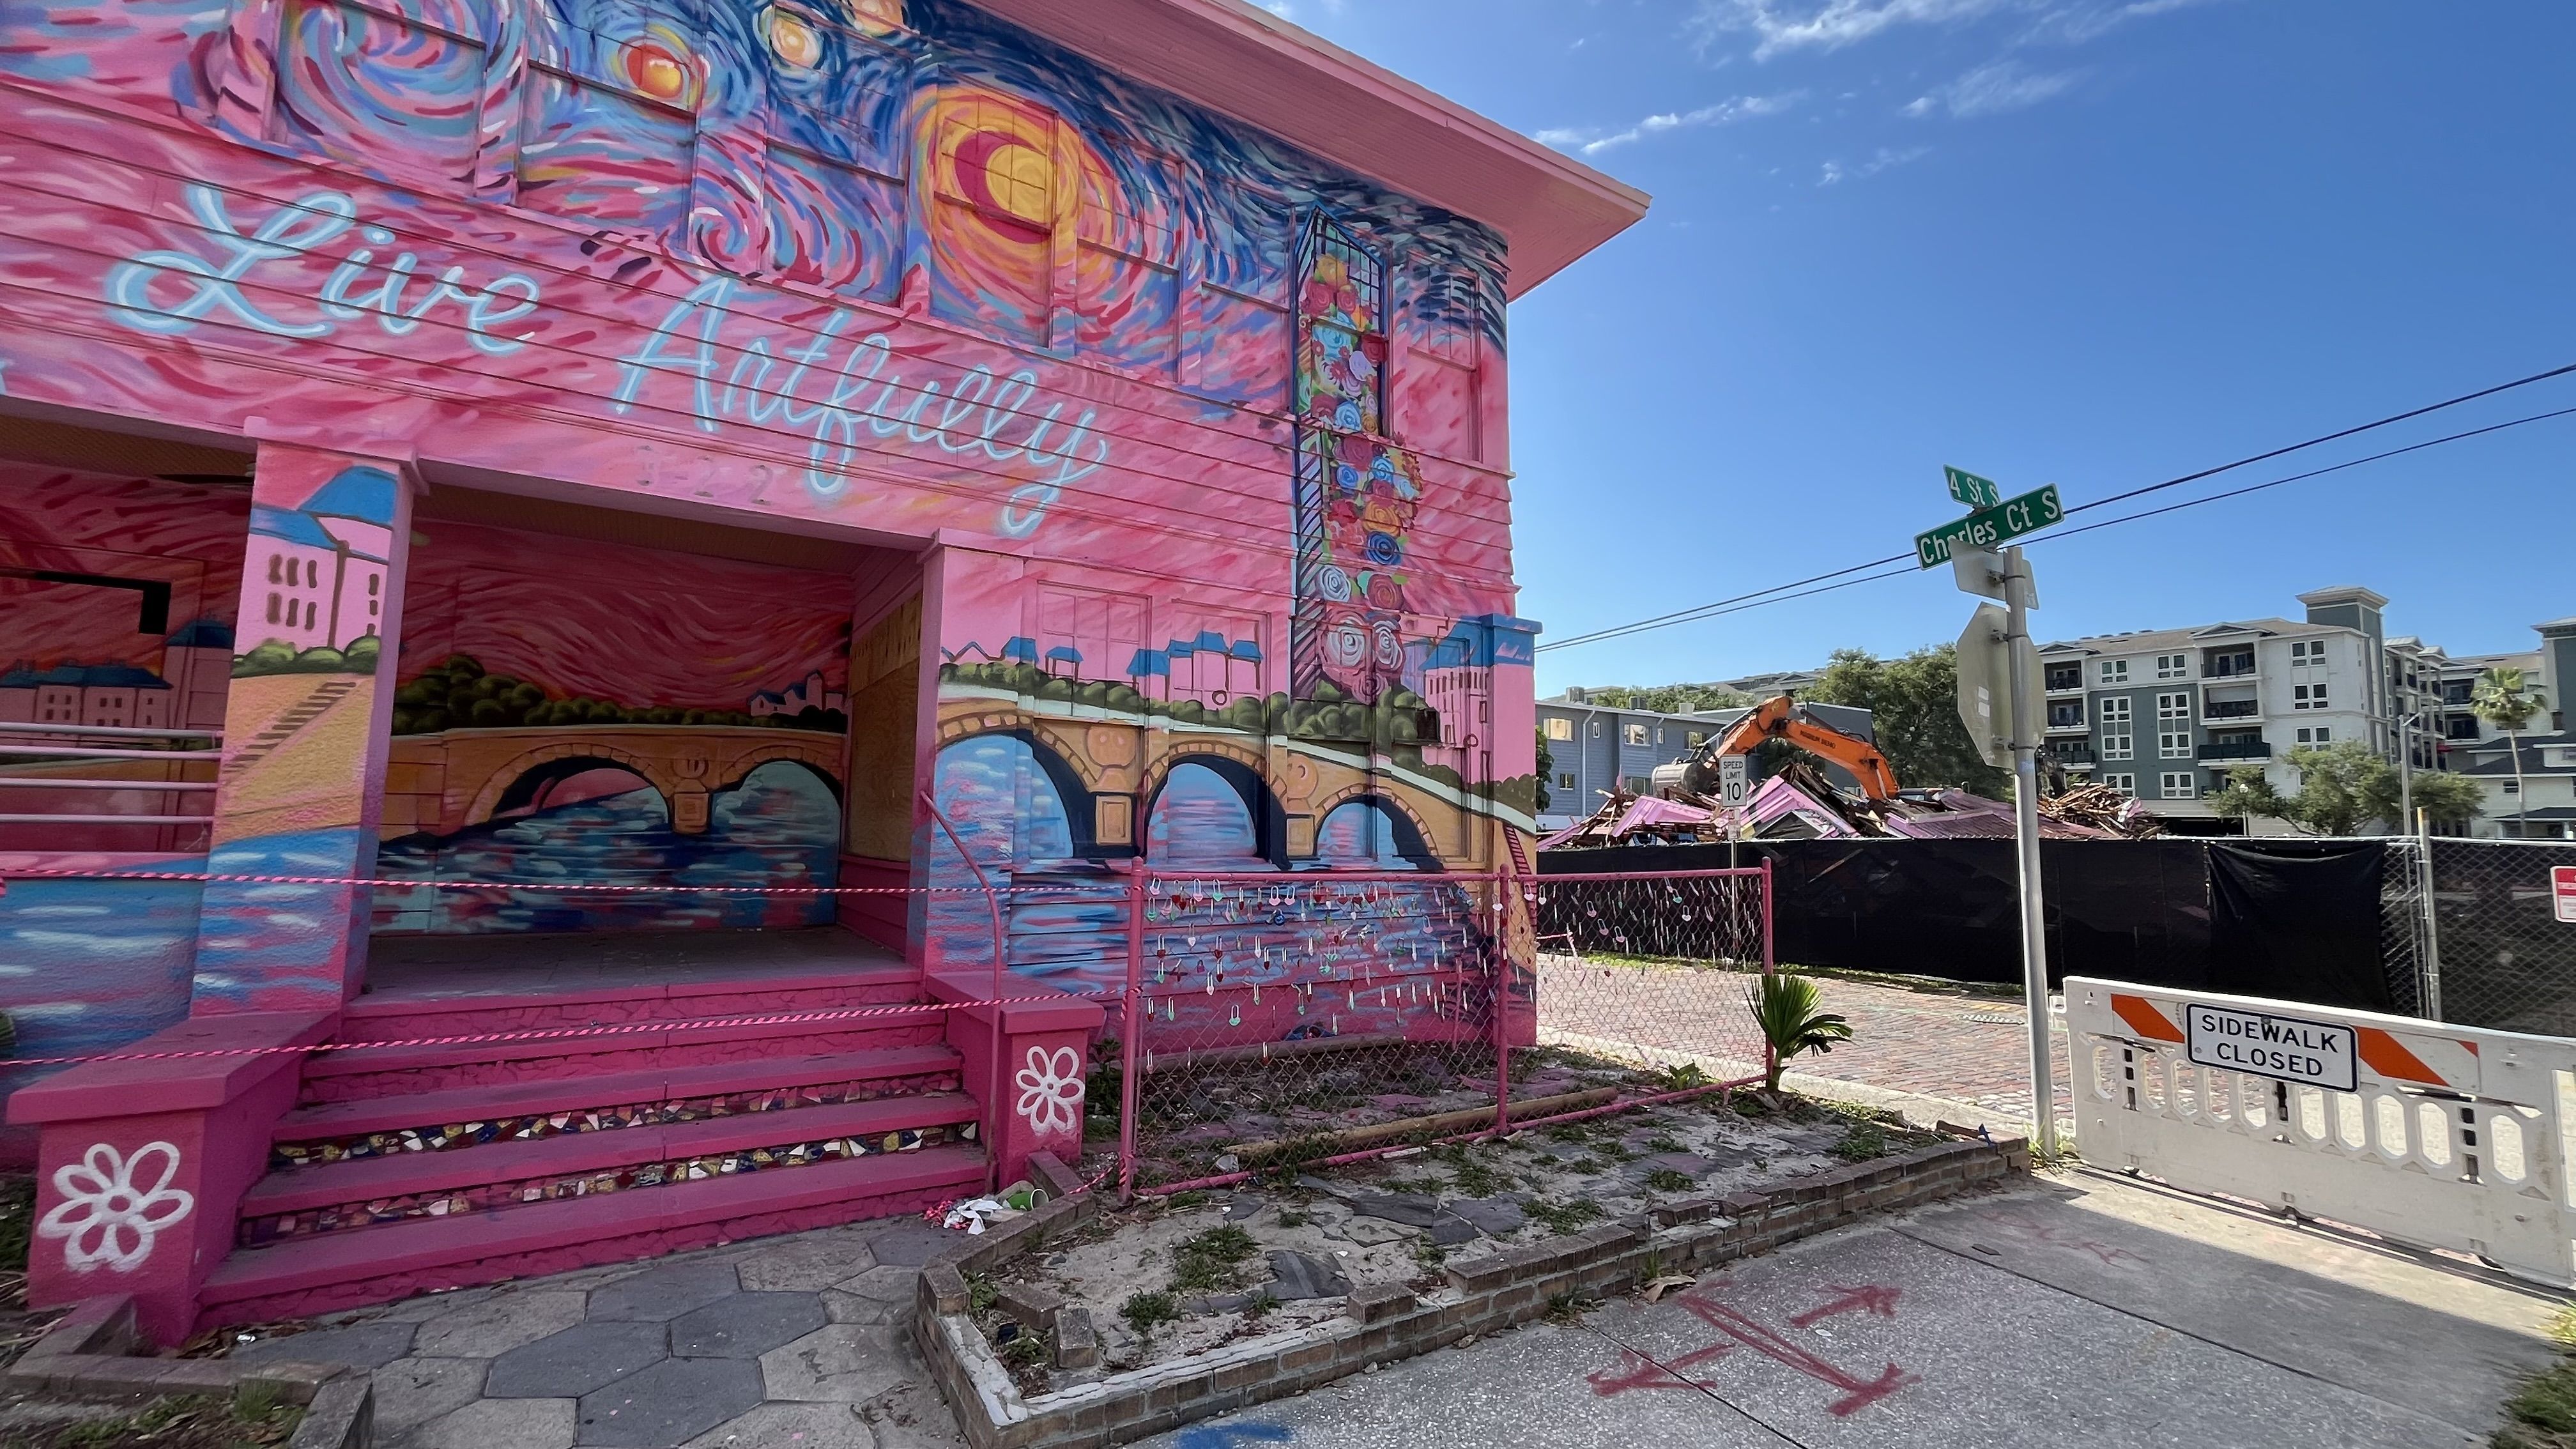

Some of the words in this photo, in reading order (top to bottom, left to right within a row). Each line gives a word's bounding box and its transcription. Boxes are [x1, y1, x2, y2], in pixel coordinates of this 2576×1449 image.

[105, 182, 539, 356] Live
[615, 275, 1110, 537] Artfully
[1951, 472, 1961, 497] 4
[1966, 477, 1985, 505] St
[1988, 484, 2000, 507] S
[1920, 521, 1997, 564] Chrles
[2006, 500, 2033, 532] Ct
[2041, 491, 2058, 519] S
[1723, 761, 1744, 769] SPEED
[1726, 771, 1741, 779] LIMIT
[1726, 782, 1741, 801] 10
[2202, 1015, 2338, 1053] SIDEWALK
[2217, 1042, 2323, 1076] CLOSED
